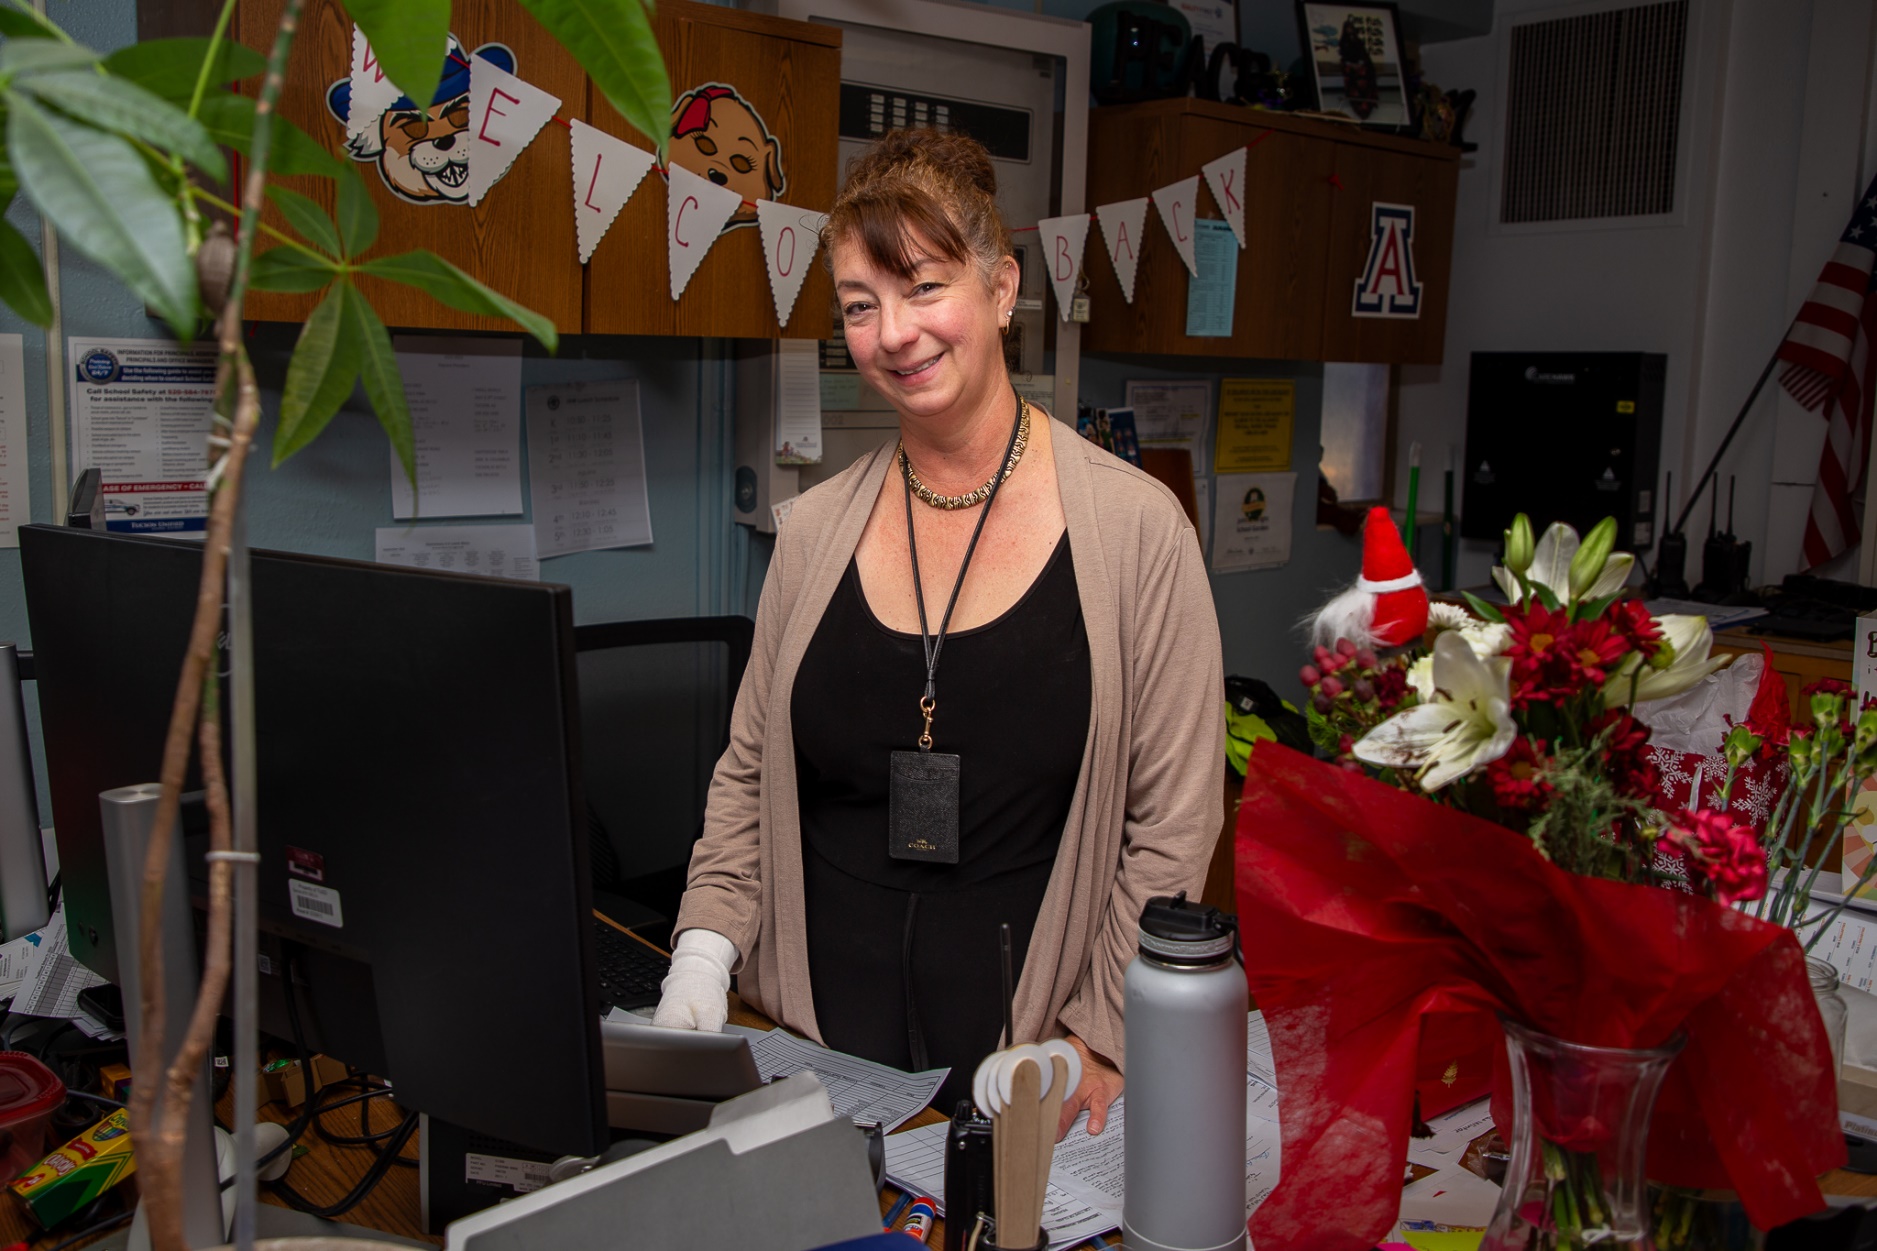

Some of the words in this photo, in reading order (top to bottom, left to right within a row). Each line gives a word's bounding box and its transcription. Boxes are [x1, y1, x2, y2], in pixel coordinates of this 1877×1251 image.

[1352, 202, 1424, 319] A
[132, 388, 156, 396] Safety
[102, 484, 119, 492] ASE
[121, 484, 132, 492] OF
[133, 483, 183, 492] EMERGENCY
[907, 842, 936, 850] COACH
